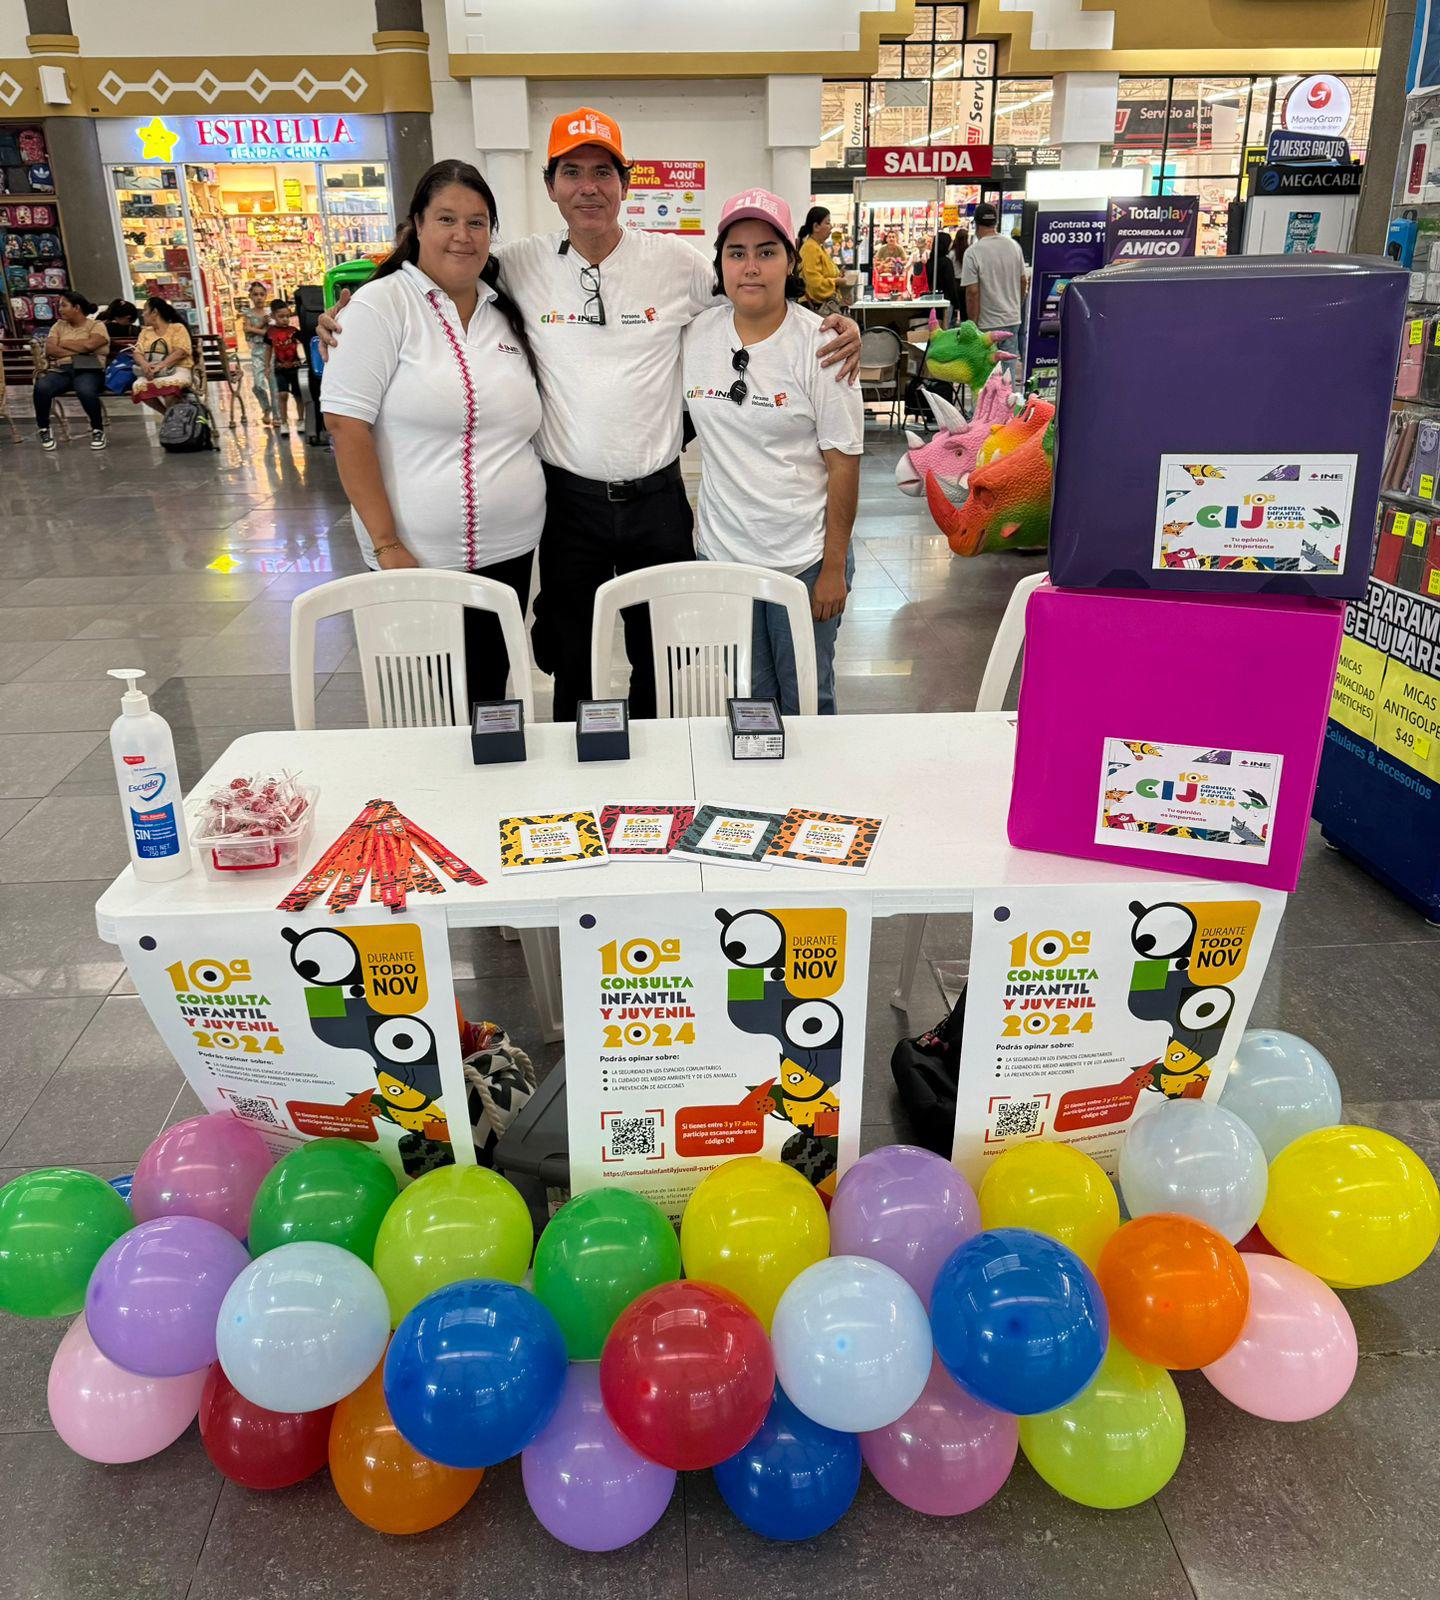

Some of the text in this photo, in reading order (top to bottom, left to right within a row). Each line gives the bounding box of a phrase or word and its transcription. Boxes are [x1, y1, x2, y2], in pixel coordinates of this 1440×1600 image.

[969, 48, 988, 122] Servcio
[1184, 107, 1195, 118] al
[1197, 107, 1212, 118] Cli
[567, 119, 596, 135] CIJ
[850, 101, 862, 146] Ofertas
[1291, 115, 1342, 125] MoneyGram
[195, 117, 355, 146] ESTRELLA
[226, 146, 330, 160] TIENDA CHINA
[1271, 140, 1345, 157] 2 MESES GRATIS
[884, 151, 974, 173] SALIDA
[1248, 155, 1266, 163] WES
[630, 164, 655, 174] obra
[668, 169, 696, 180] AQUÍ
[630, 174, 661, 185] Envía
[1280, 173, 1361, 187] MEGACABL
[1128, 206, 1187, 222] Totalplay
[1049, 221, 1090, 230] ¡Contrata
[1041, 232, 1066, 244] 800
[1067, 231, 1092, 243] 330
[1120, 241, 1180, 255] AMIGO
[1196, 505, 1265, 529] CIJ
[1266, 521, 1305, 529] 2024
[1343, 606, 1440, 679] CELULARE
[1338, 654, 1362, 675] MICAS
[1335, 672, 1375, 701] RIVACIDAD
[1403, 683, 1437, 711] MICAS
[1333, 688, 1374, 721] IMETICHES)
[1383, 698, 1440, 740] ANTIGOLPE
[1325, 725, 1432, 800] Celulares & accesorios
[129, 779, 158, 792] Escudo
[1135, 778, 1198, 803] CIJ
[1200, 788, 1233, 796] INFANTIL
[1201, 784, 1236, 792] CONSULTA
[1200, 798, 1236, 808] 2024
[1168, 813, 1207, 822] importante
[1176, 808, 1202, 816] opinión
[135, 829, 151, 840] SIN
[1201, 926, 1247, 937] DURANTE
[793, 935, 838, 946] DURANTE
[1200, 937, 1243, 949] TODO
[793, 947, 837, 959] TODO
[1008, 929, 1091, 967] 10ª
[367, 952, 415, 963] DURANTE
[597, 938, 681, 975] 10ª
[1196, 949, 1242, 968] NOV
[164, 958, 252, 993] 10ª
[369, 963, 416, 976] TODO
[793, 960, 838, 980] NOV
[1006, 968, 1099, 982] CONSULTA
[373, 976, 419, 996] NOV
[600, 976, 694, 990] CONSULTA
[1005, 983, 1090, 996] INFANTIL
[175, 994, 271, 1006] CONSULTA
[601, 991, 687, 1005] INFANTIL
[1003, 997, 1096, 1010] Y JUVENIL
[180, 1006, 267, 1019] INFANTIL
[600, 1006, 696, 1020] Y JUVENIL
[183, 1017, 279, 1032] Y JUVENIL
[1000, 1012, 1093, 1037] 2024
[602, 1022, 696, 1048] 2024
[192, 1031, 285, 1055] 2024
[1024, 1043, 1049, 1051] opinar
[599, 1055, 627, 1063] Podrás
[628, 1055, 654, 1063] opinar
[682, 1130, 708, 1139] participa
[705, 1137, 725, 1145] código
